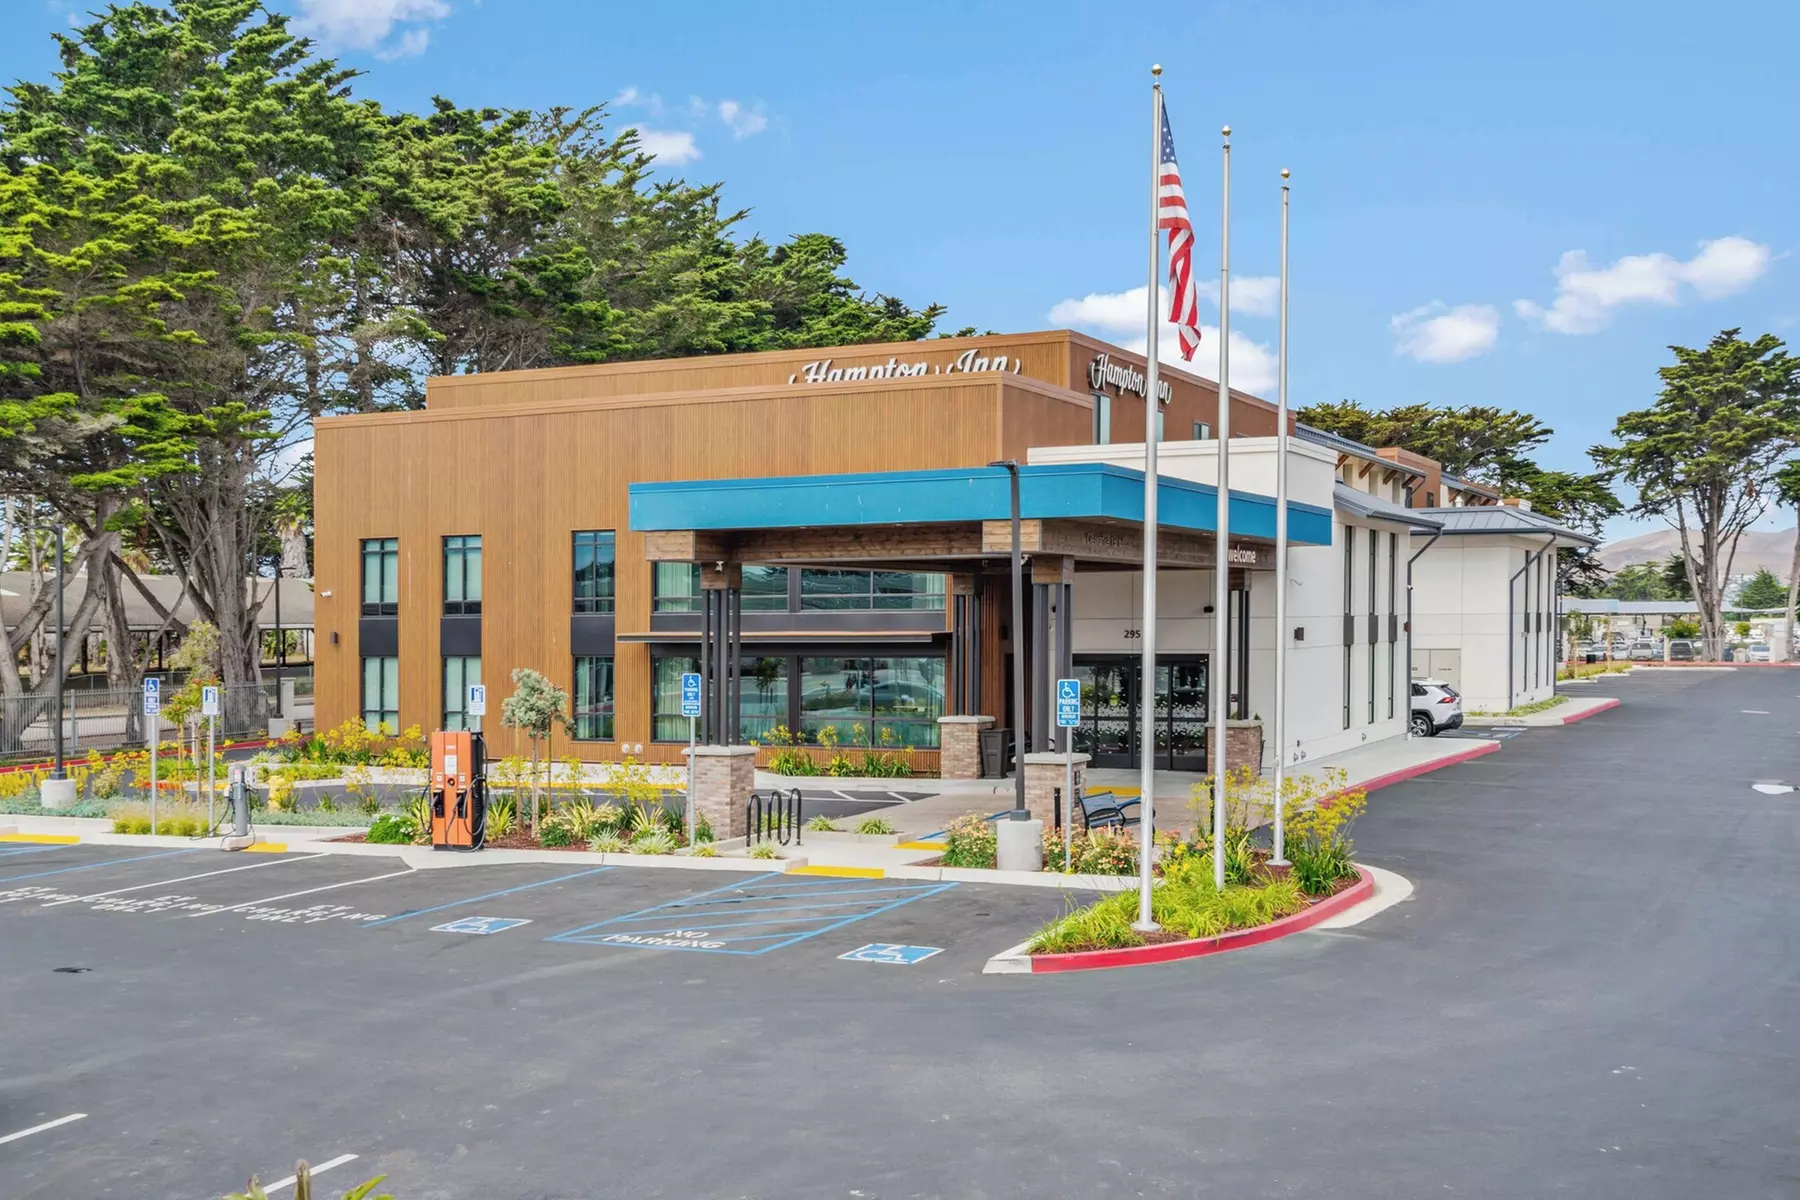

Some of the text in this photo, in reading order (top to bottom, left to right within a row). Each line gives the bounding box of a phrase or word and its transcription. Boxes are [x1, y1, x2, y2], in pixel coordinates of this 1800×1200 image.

[946, 348, 1021, 375] Inn
[1087, 353, 1148, 398] Hampton
[1227, 544, 1257, 564] welcome
[1123, 629, 1141, 639] 295
[82, 897, 224, 910] CHARGING
[91, 904, 169, 913] ONLY
[233, 907, 386, 920] CHARGING
[245, 914, 327, 923] ONLY
[664, 930, 709, 938] NO
[602, 935, 726, 948] PARKING
